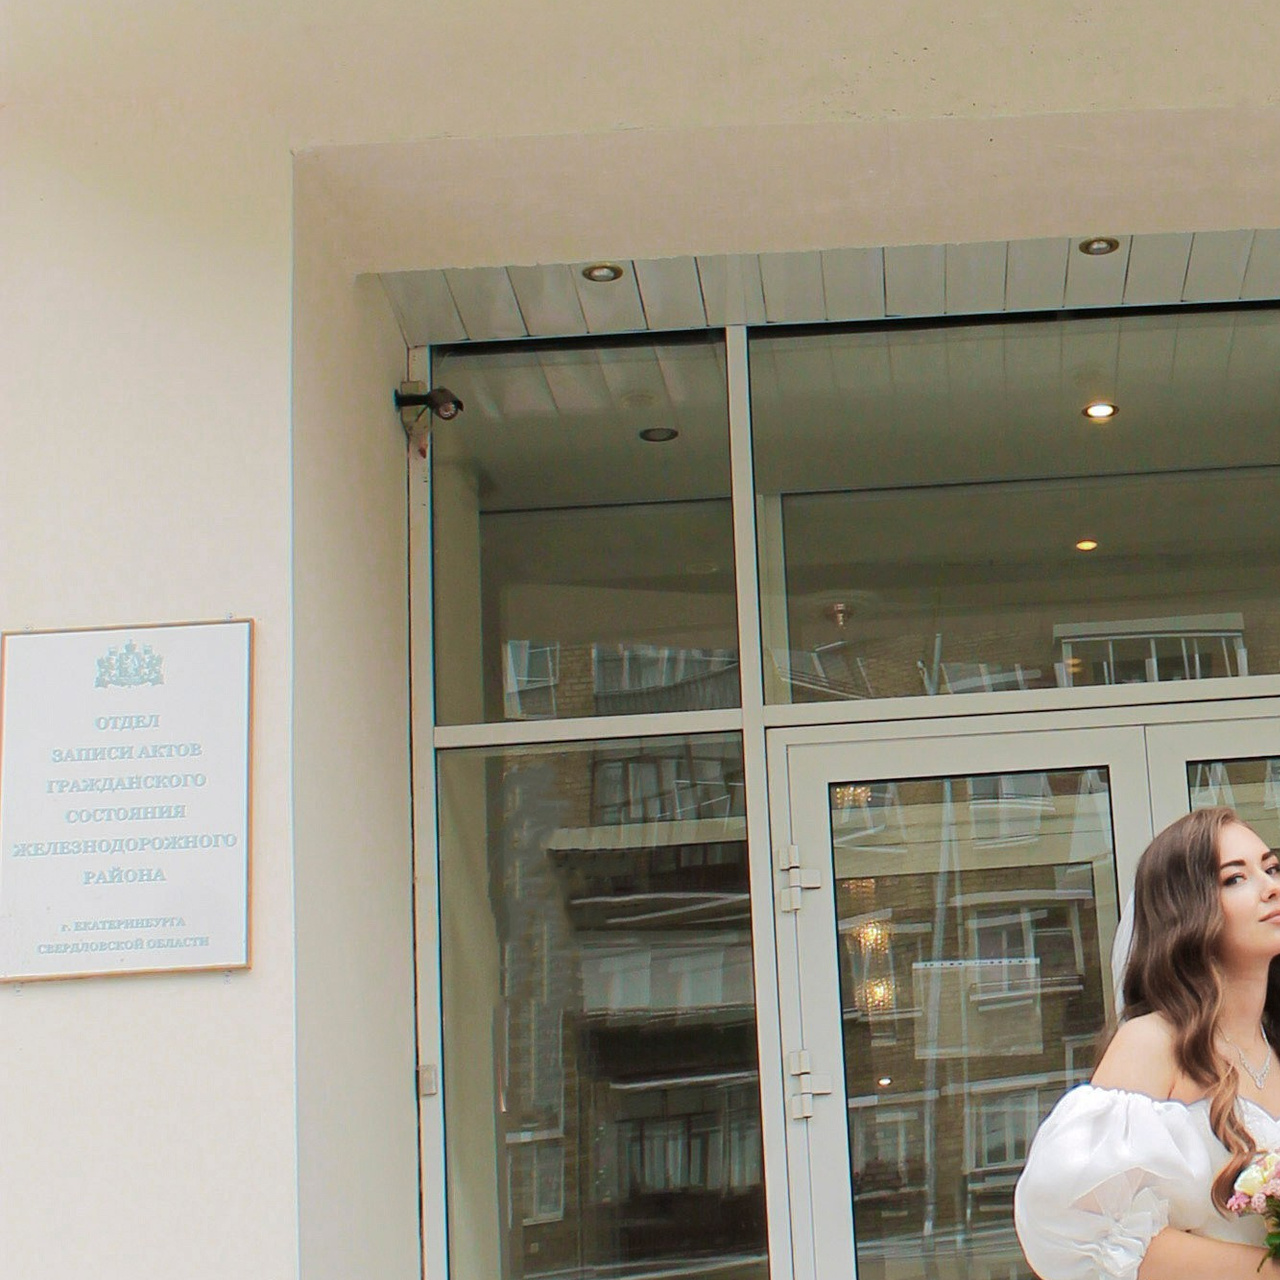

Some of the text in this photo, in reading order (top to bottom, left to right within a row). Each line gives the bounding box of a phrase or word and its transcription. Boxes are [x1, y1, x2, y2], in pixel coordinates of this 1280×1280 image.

[95, 714, 160, 730] ОТДЕЛ
[52, 743, 202, 763] ЗАПИСИ АКТОВ
[46, 774, 207, 794] ГРАЖДАНСКОГО
[65, 805, 186, 824] СОСТОЯНИЯ
[12, 833, 237, 857] ЖЕЛЕЗНОДОРОЖНОГО
[82, 866, 166, 885] РАЙОНА
[37, 935, 209, 955] СВЕРДЛОВСКОЙ ОБЛАСТИ
